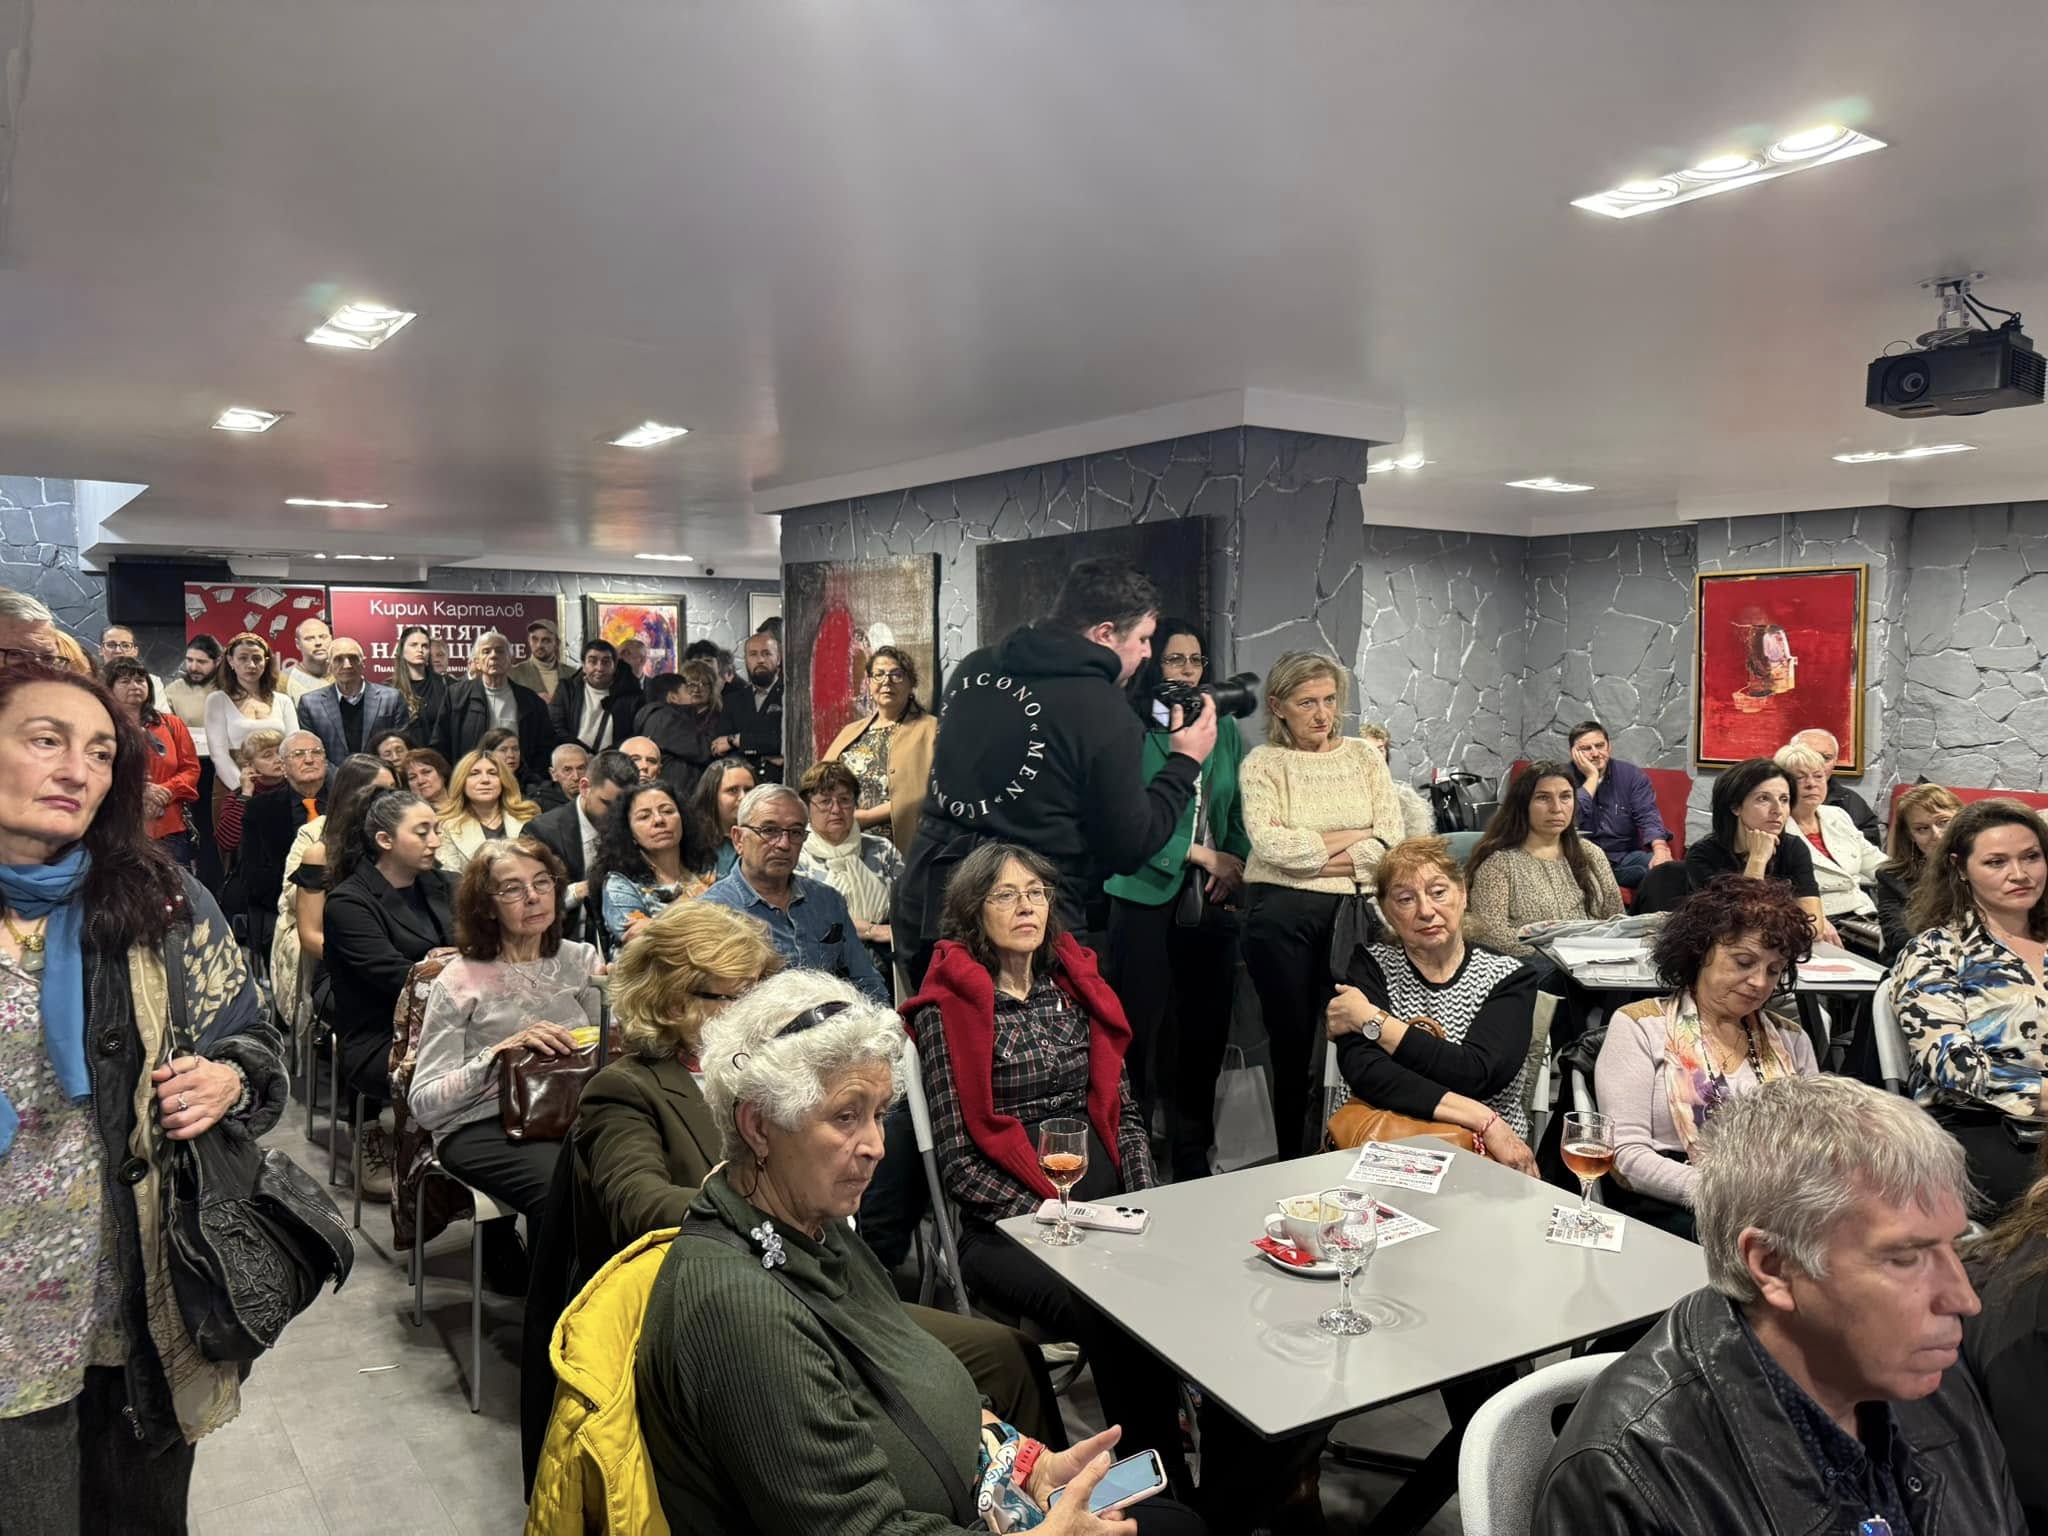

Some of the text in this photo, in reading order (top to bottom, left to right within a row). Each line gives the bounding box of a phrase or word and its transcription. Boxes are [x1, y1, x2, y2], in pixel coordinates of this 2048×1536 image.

[370, 600, 524, 619] Кирил Карталов
[396, 624, 499, 641] ЕТЯТ
